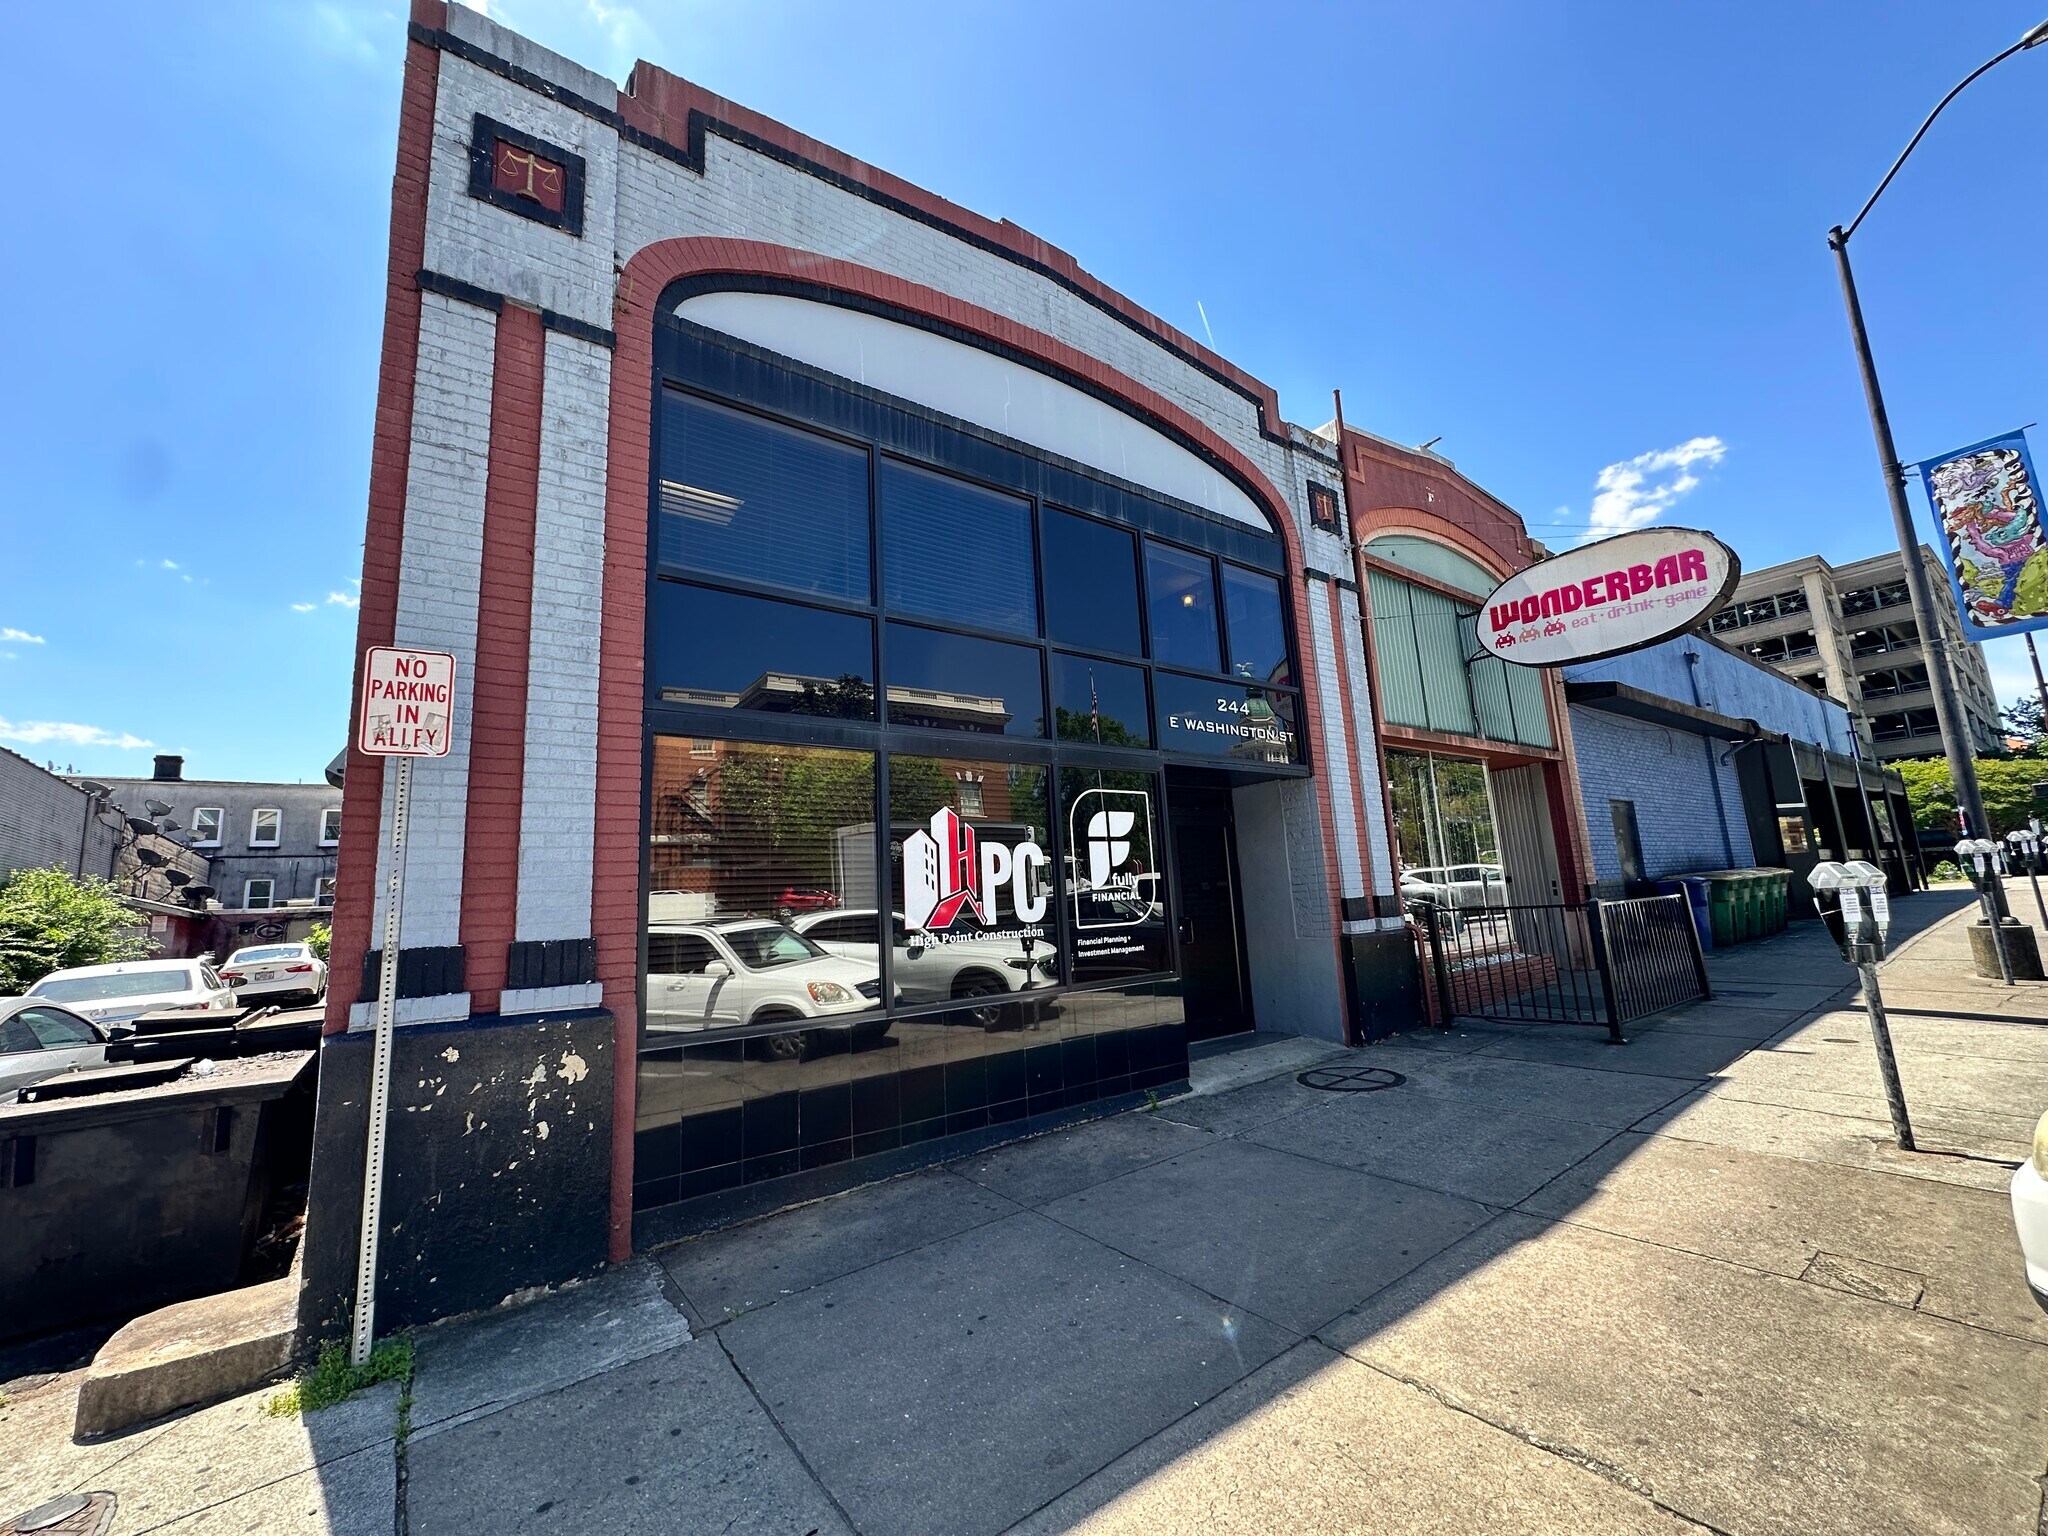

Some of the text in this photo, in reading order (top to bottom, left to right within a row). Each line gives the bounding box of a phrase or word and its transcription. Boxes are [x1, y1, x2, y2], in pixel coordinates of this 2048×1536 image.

[1489, 549, 1708, 632] WONDERBAR
[1607, 598, 1654, 620] drink
[1664, 586, 1708, 608] game
[395, 658, 427, 678] NO
[371, 680, 447, 702] PARKING
[396, 704, 419, 724] IN
[1216, 698, 1250, 715] 244
[1169, 716, 1294, 743] E WASHINGTON ST
[1112, 872, 1140, 888] fully
[1092, 891, 1141, 902] FINANCIAL
[910, 927, 1045, 949] High Point Construction
[1077, 937, 1103, 946] Financial
[1078, 945, 1144, 958] Investment Management
